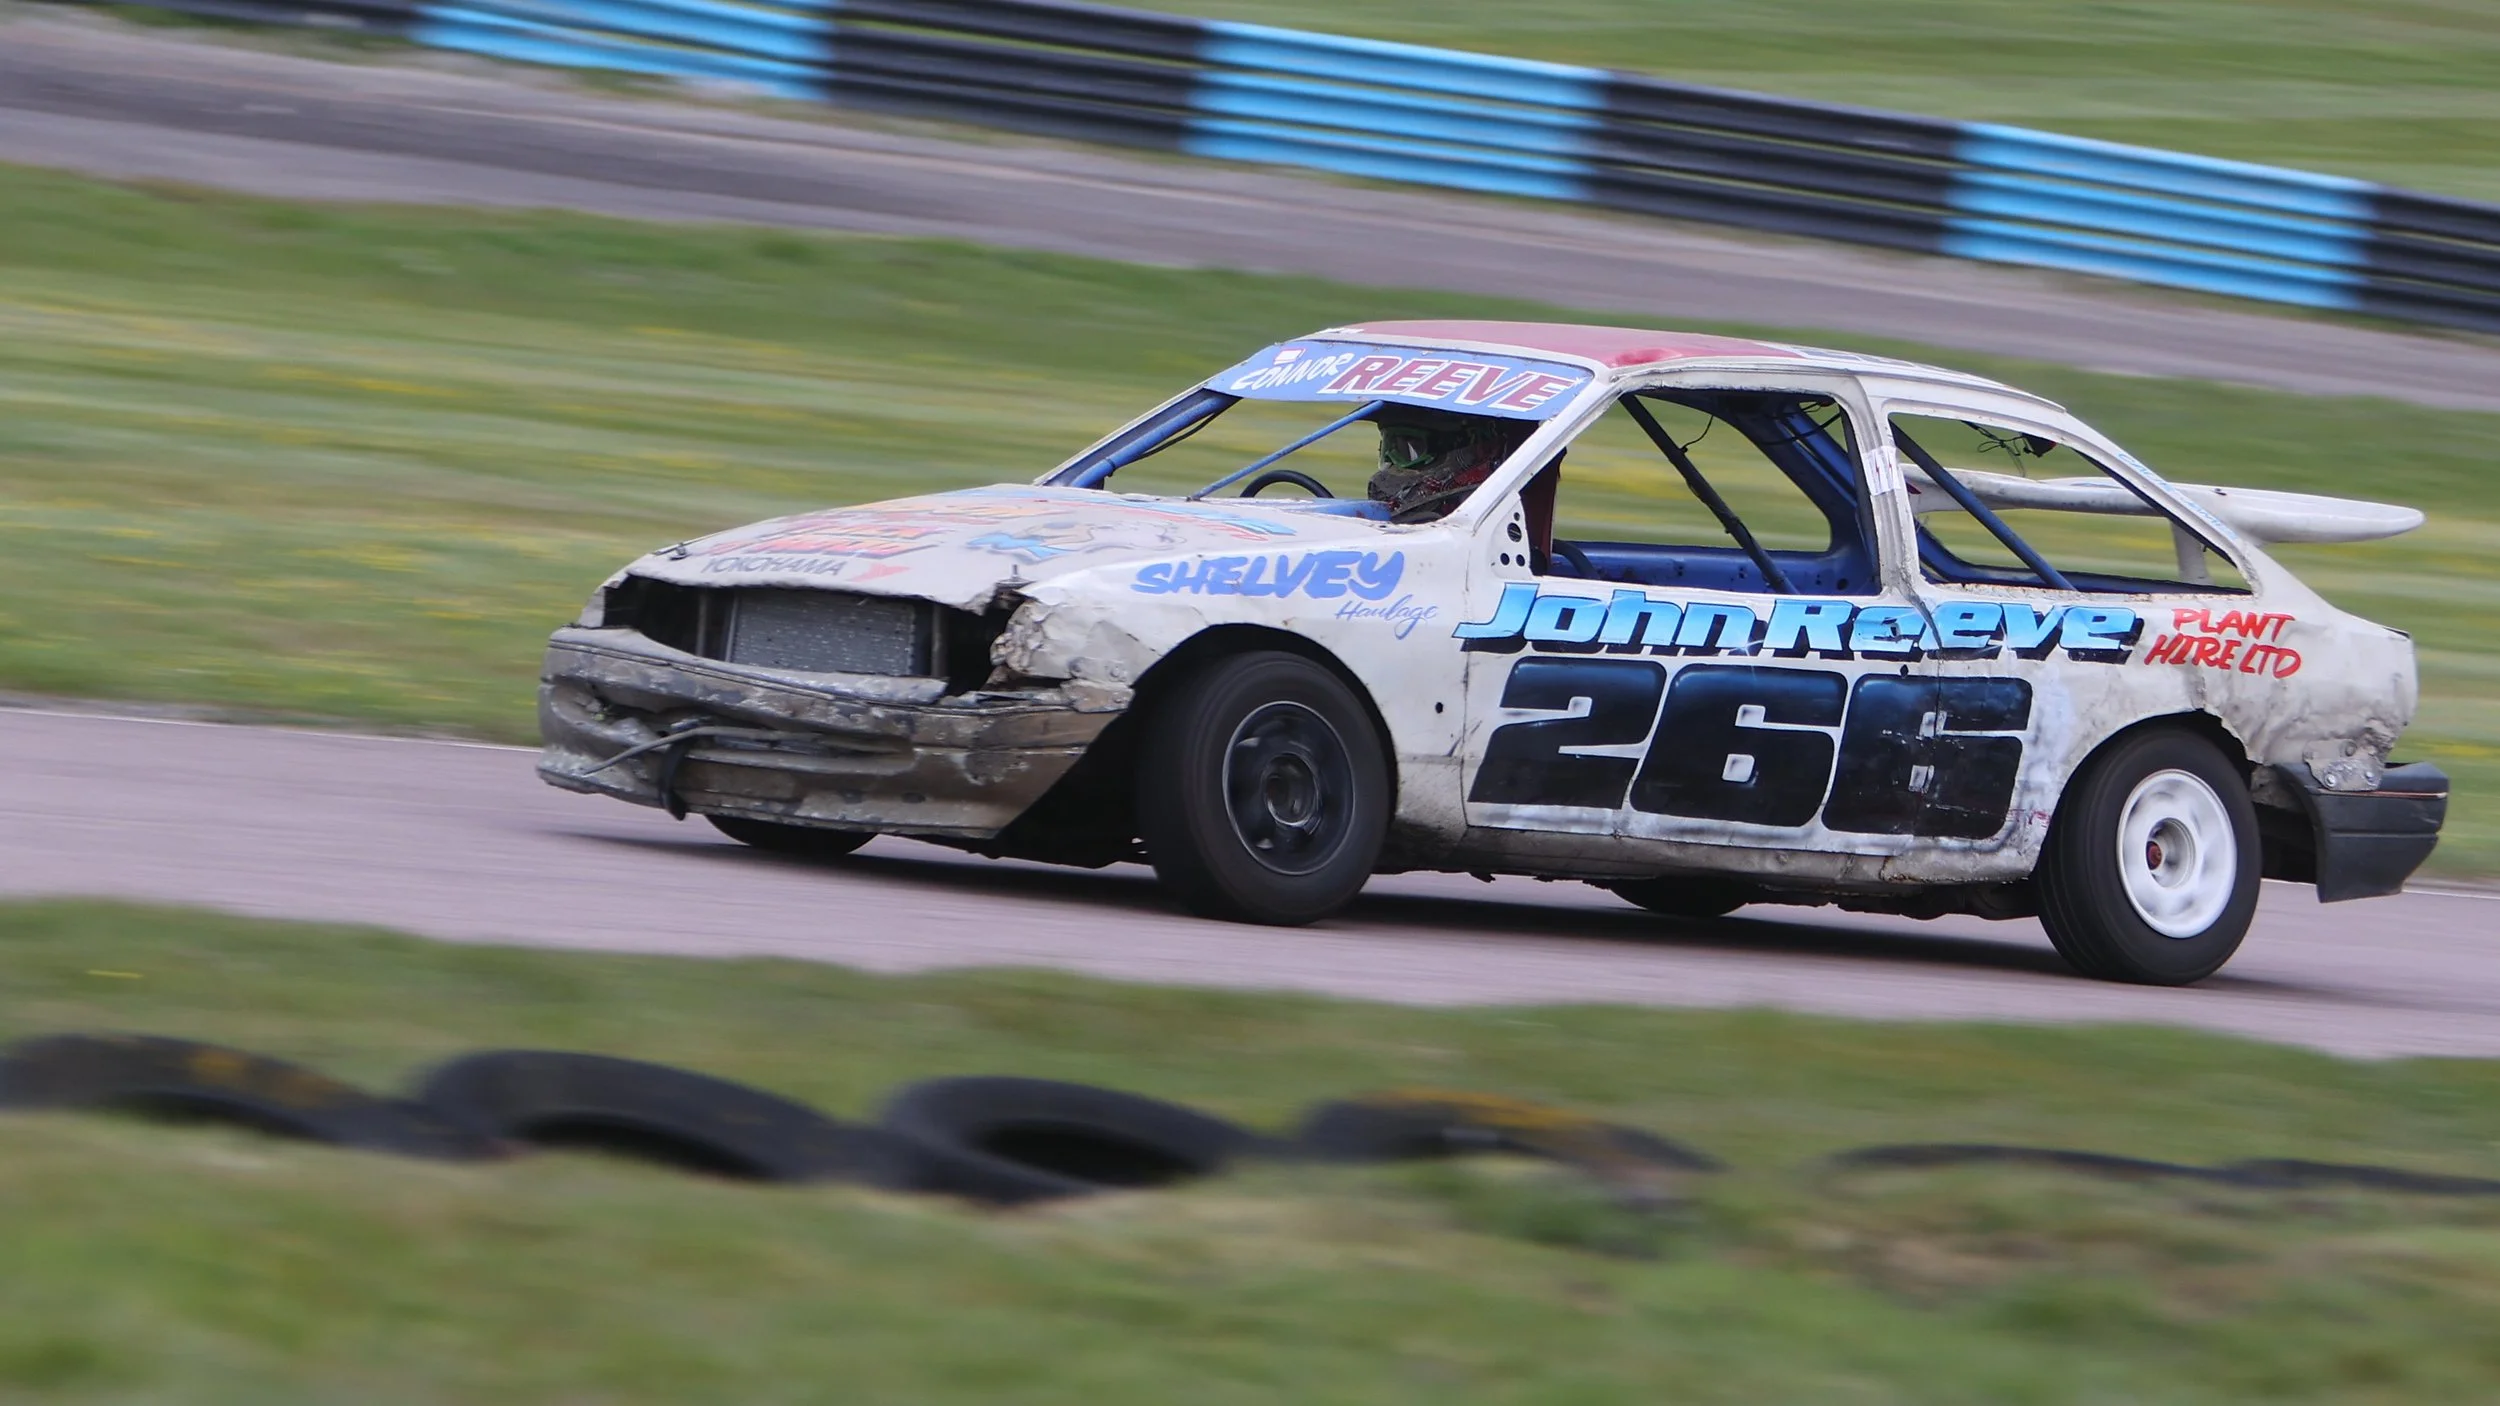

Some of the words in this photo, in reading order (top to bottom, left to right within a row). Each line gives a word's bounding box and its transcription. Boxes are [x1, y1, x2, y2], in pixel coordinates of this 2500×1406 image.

[1230, 352, 1356, 391] CONNOR
[1316, 355, 1579, 412] REEVE
[701, 556, 847, 576] YOKOHAMA
[1130, 550, 1405, 600] SHELVEY
[1334, 595, 1439, 640] Haulage
[2171, 608, 2296, 642] PLANT
[2143, 633, 2242, 670] HIRE
[2238, 643, 2303, 679] LTD
[1468, 656, 2034, 839] 266
